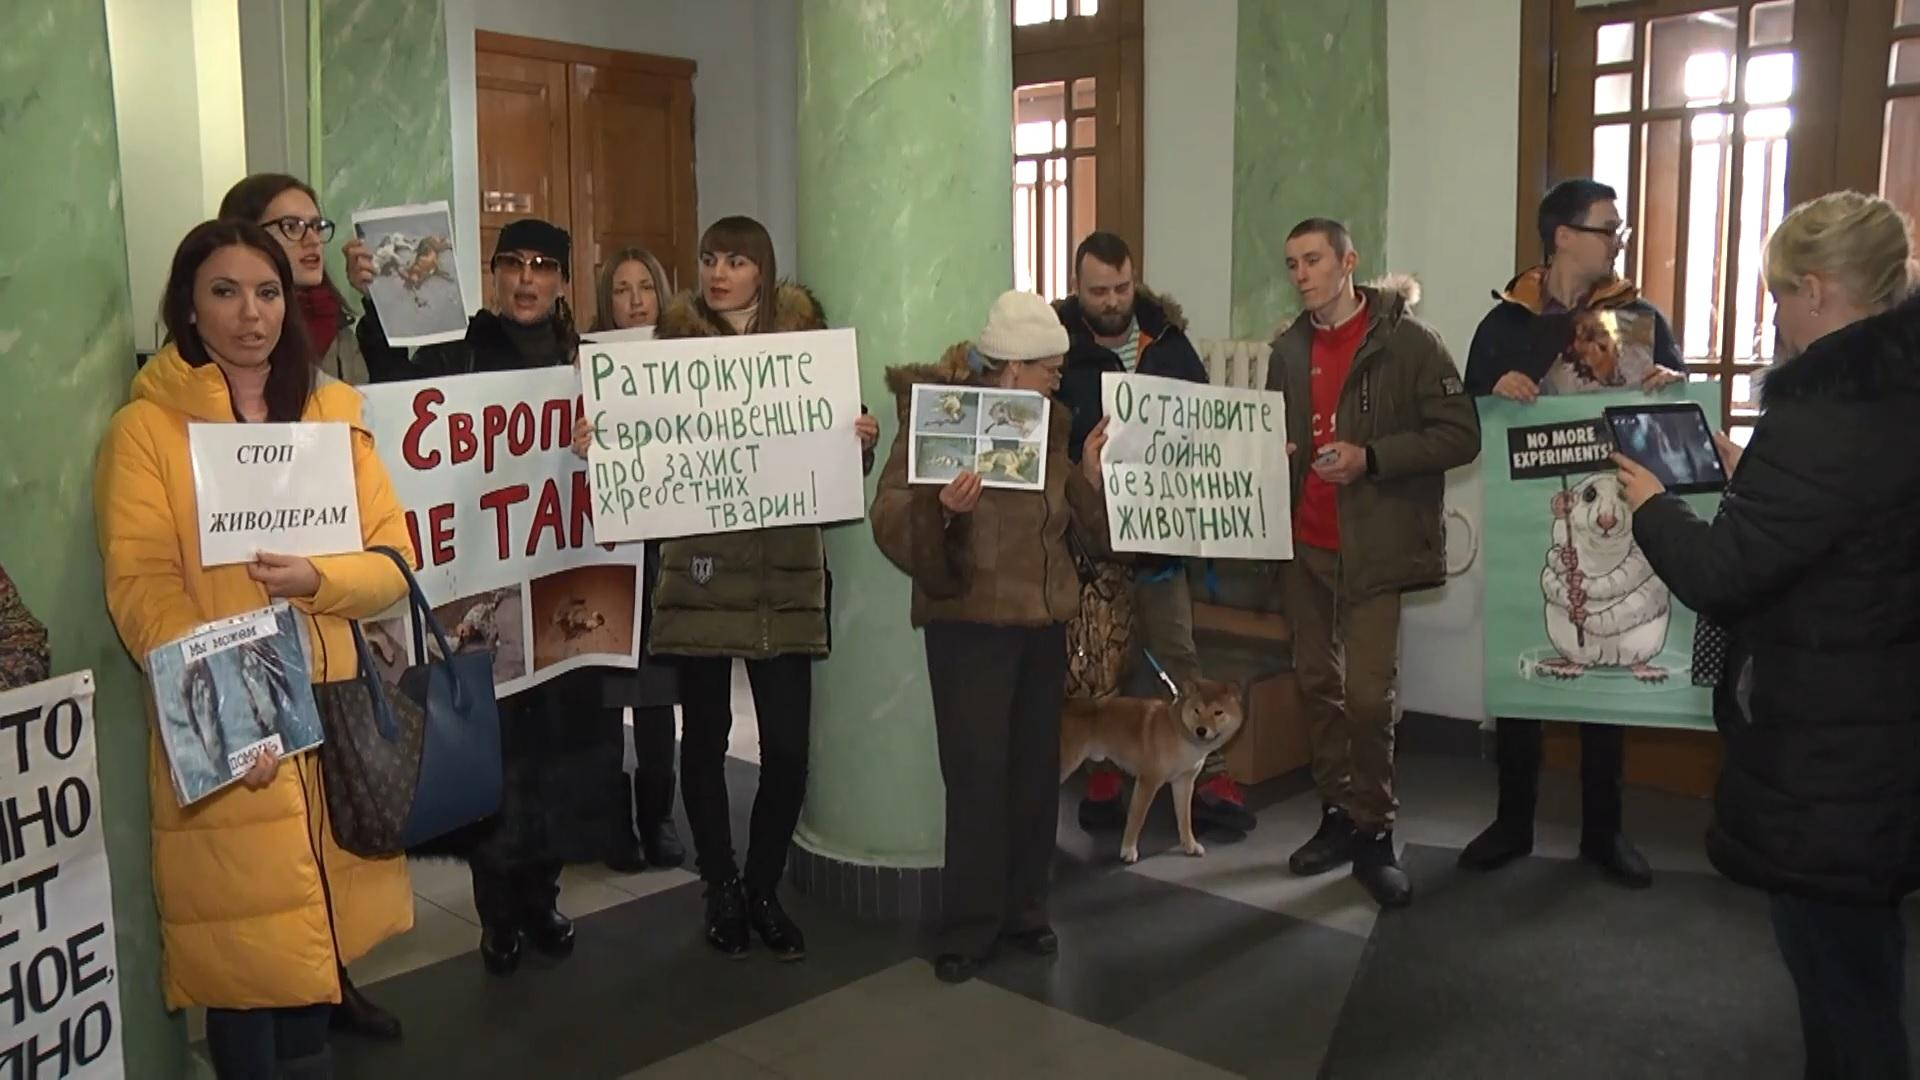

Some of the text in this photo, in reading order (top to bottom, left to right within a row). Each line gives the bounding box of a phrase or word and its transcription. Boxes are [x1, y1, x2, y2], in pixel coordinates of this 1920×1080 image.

[591, 350, 813, 408] Ратифікуйте
[402, 387, 587, 473] ЕВРОП
[594, 395, 833, 459] Євроконвенцію
[1115, 380, 1273, 433] Остановите
[237, 444, 294, 464] СТОП
[1145, 429, 1222, 468] бойню
[1526, 426, 1596, 449] NO MORE
[596, 445, 760, 502] про захист
[706, 470, 818, 528] тварин!
[209, 505, 347, 533] ЖИВОДЕРАМ
[600, 476, 749, 525] хребетних
